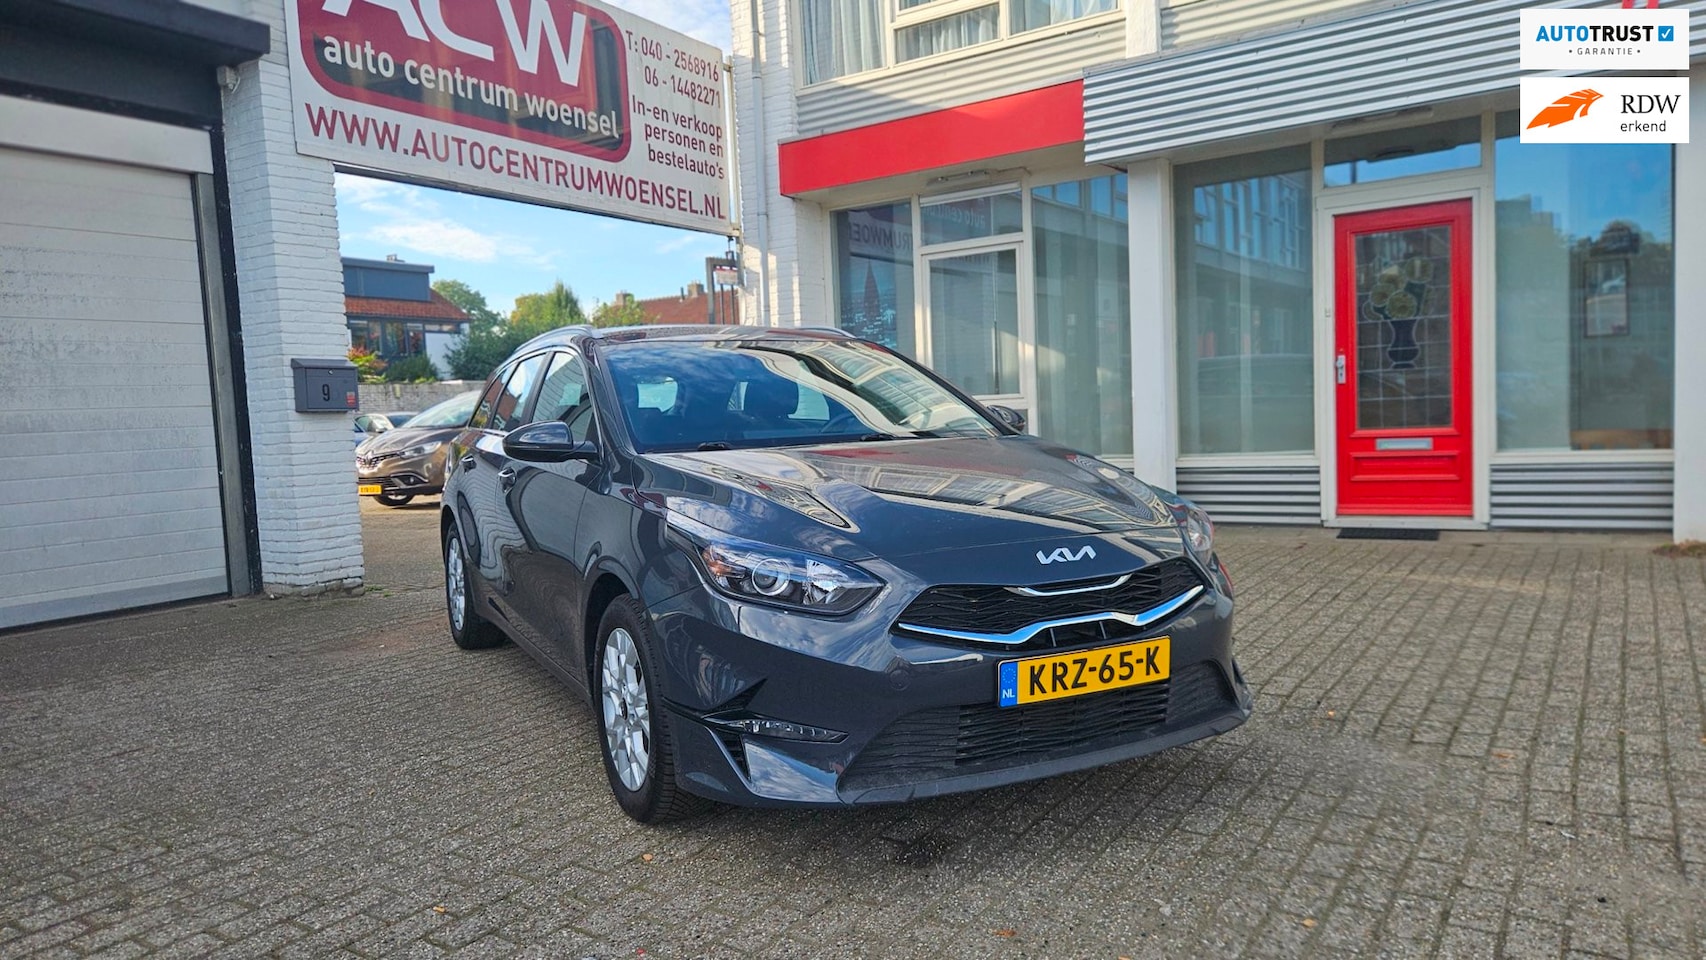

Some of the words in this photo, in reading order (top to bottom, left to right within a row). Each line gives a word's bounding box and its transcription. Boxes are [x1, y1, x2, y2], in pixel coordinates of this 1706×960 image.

[625, 30, 639, 53] T:
[641, 36, 663, 61] 040
[674, 49, 719, 82] 2568916
[323, 35, 395, 78] auto
[404, 59, 519, 112] centrum
[524, 91, 620, 138] woensel
[644, 65, 659, 87] 06
[670, 74, 721, 109] 14482271
[632, 95, 669, 123] In-en
[672, 111, 723, 141] verkoop
[644, 123, 706, 153] personen
[709, 143, 724, 158] en
[304, 103, 726, 220] WWW.AUTOCENTRUMWOENSEL.NL
[648, 144, 725, 180] bestelauto's
[321, 383, 331, 402] 9
[1035, 545, 1097, 565] KIA
[1002, 688, 1016, 699] NL
[1029, 646, 1161, 696] KRZ-65-K
